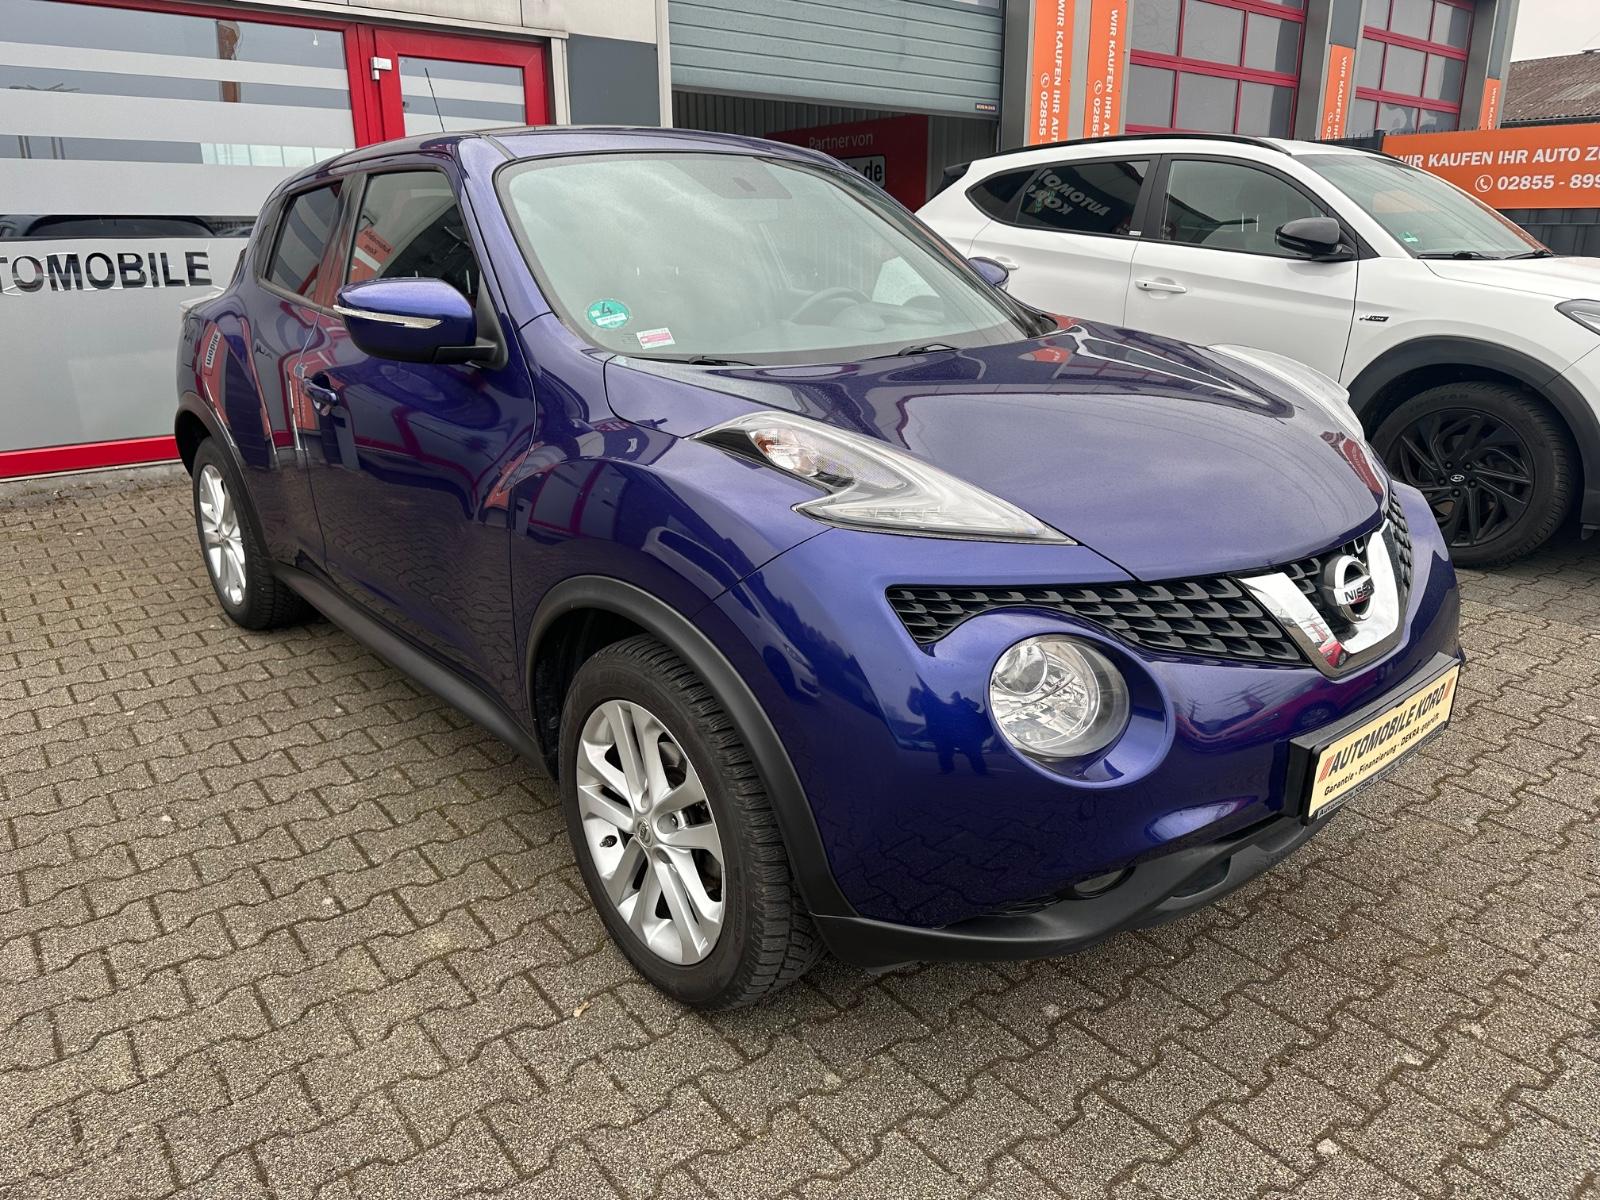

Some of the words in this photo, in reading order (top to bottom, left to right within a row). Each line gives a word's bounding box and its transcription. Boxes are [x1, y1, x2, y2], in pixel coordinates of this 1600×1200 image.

[1110, 10, 1118, 36] WIR
[1054, 31, 1063, 86] KAUFEN
[1106, 40, 1115, 93] KAUFEN
[1039, 91, 1048, 136] 02855
[1052, 90, 1060, 113] IHR
[1335, 81, 1344, 122] KAUFEN
[808, 136, 850, 150] Partner
[851, 133, 873, 147] von
[1428, 152, 1493, 167] KAUFEN
[1498, 150, 1528, 165] IHR
[1532, 147, 1581, 163] AUTO
[1497, 175, 1555, 190] 02855
[1327, 703, 1417, 777] AUTOMOBILE
[1415, 683, 1446, 722] KORO
[1324, 772, 1354, 796] Garantie
[1359, 744, 1397, 775] Finanzierung
